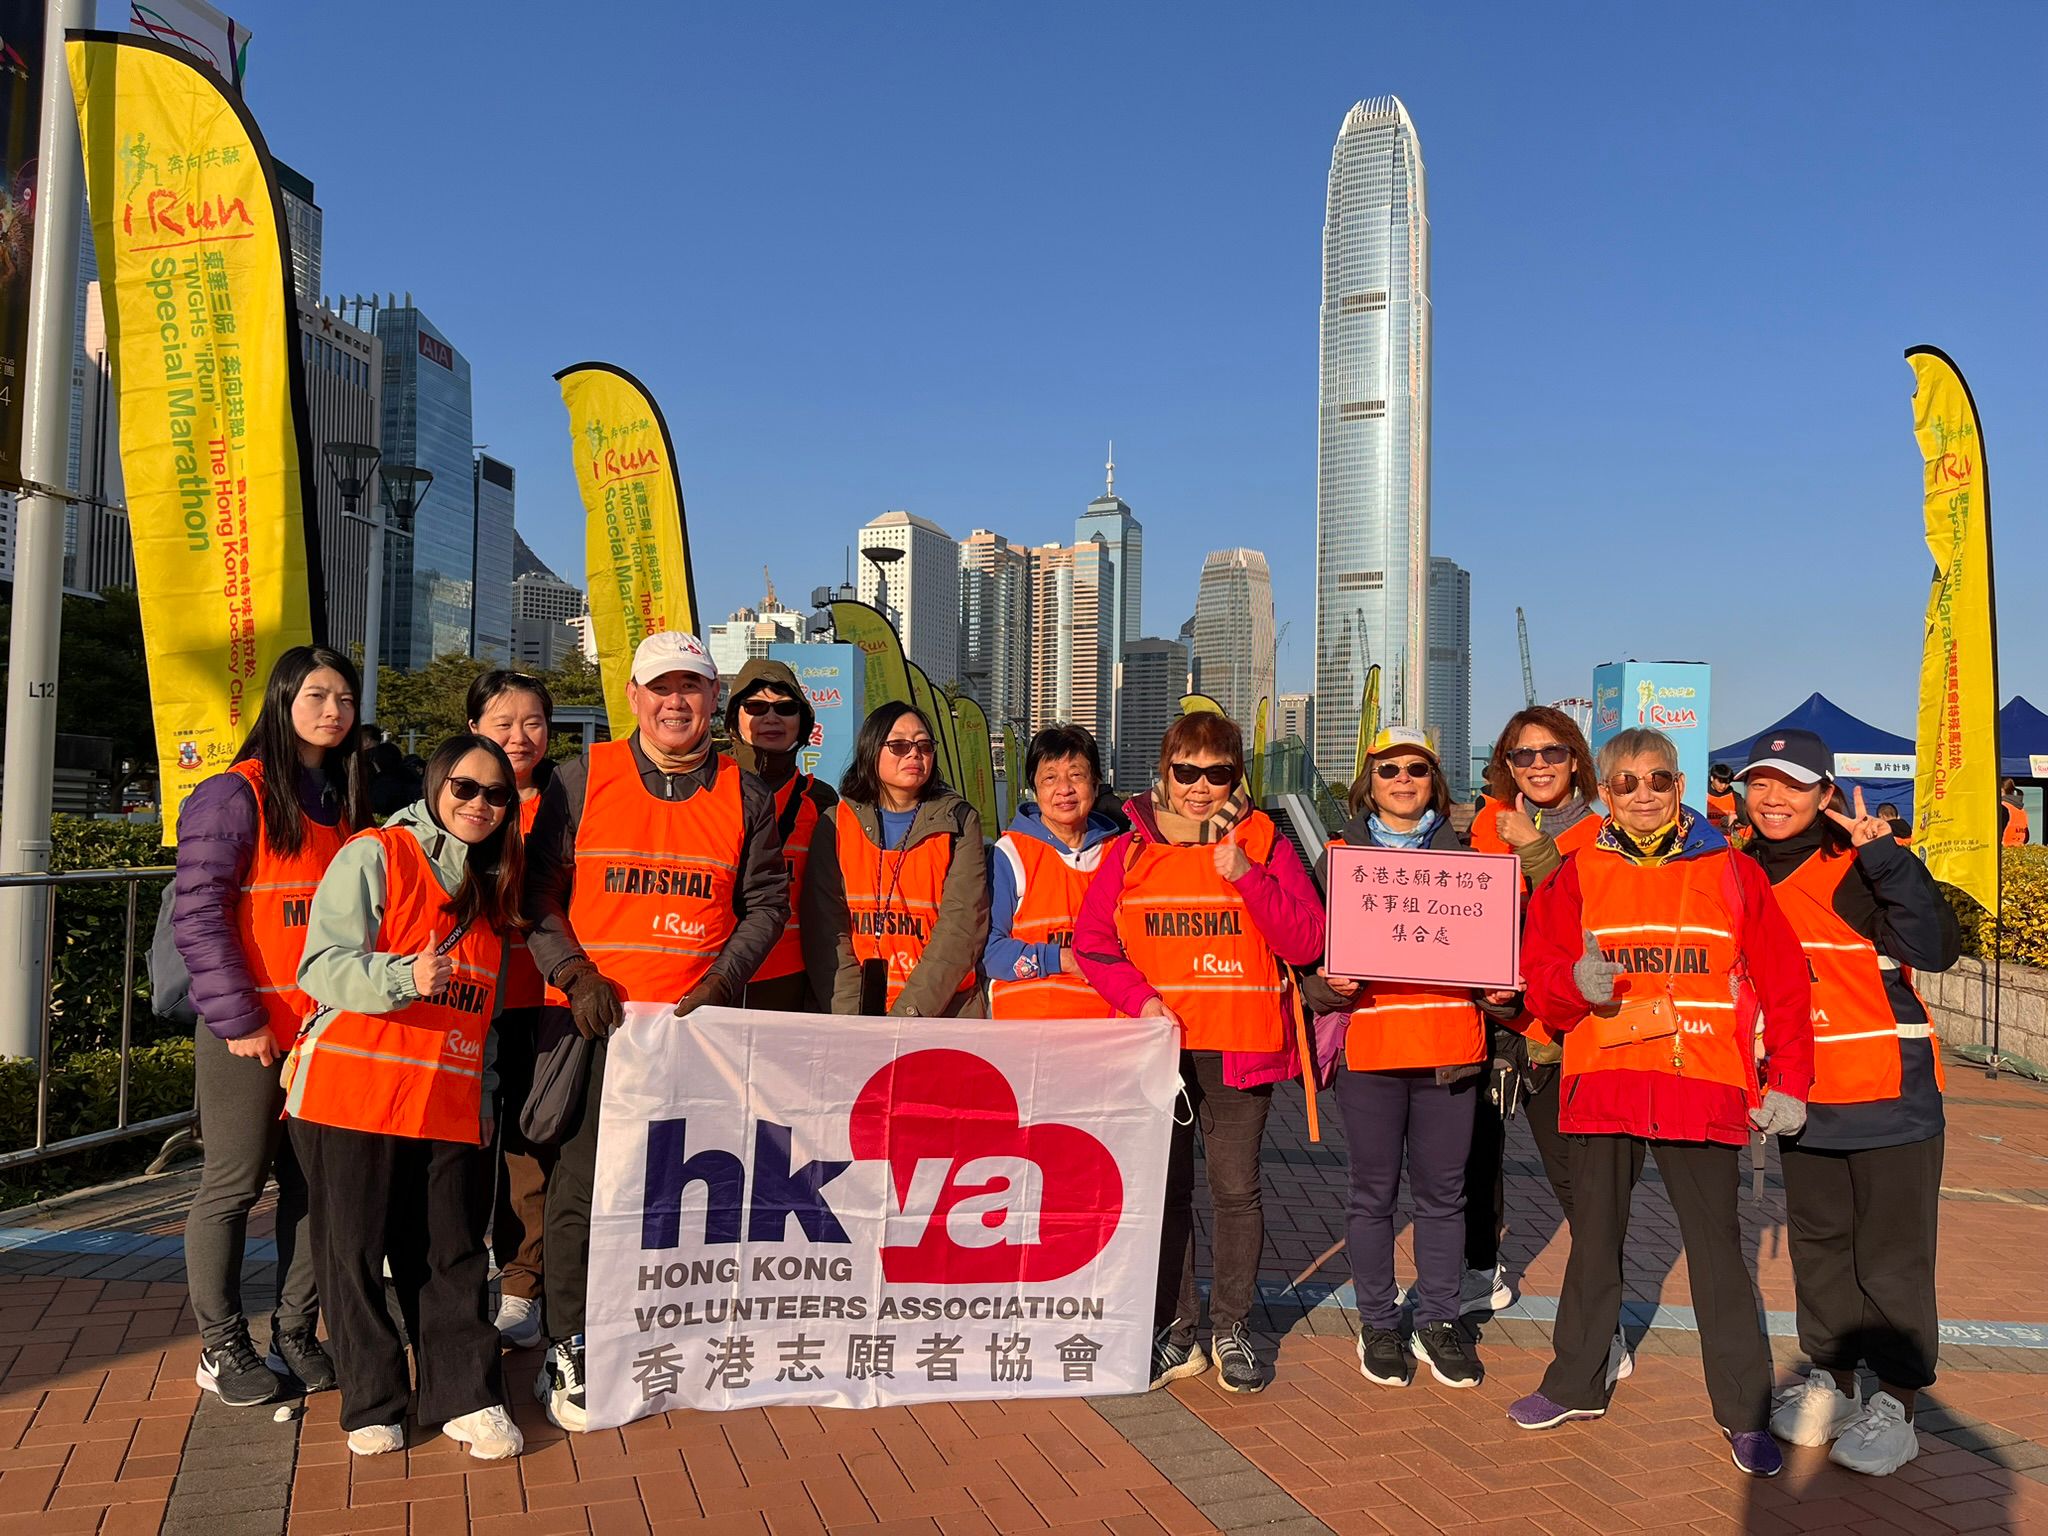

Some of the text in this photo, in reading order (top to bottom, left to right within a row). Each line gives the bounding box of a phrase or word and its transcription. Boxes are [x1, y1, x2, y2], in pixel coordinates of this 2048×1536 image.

[168, 146, 241, 175] 奔向共融
[182, 251, 208, 338] TWGHs
[423, 337, 449, 367] AIA
[146, 257, 211, 551] Special Marathon
[208, 435, 227, 476] The
[214, 479, 233, 537] Hong
[604, 487, 629, 562] Special
[619, 484, 636, 535] TWGHs
[640, 591, 653, 616] The
[222, 541, 239, 598] Kong
[228, 602, 243, 674] Jockey
[29, 681, 55, 698] L12
[229, 678, 244, 727] Club
[1874, 763, 1910, 772] 晶片計時
[1934, 769, 1947, 800] Club
[604, 867, 713, 899] MARSHAL
[1351, 865, 1493, 890] 香港志願者協會
[1144, 911, 1242, 936] MARSHAL
[1361, 894, 1483, 917] 賽事組 Zone3
[1392, 923, 1451, 945] 集合處
[640, 1118, 1045, 1251] hkva
[637, 1256, 853, 1291] HONG KONG
[634, 1296, 1104, 1332] VOLUNTEERS ASSOCIATION
[632, 1332, 1104, 1401] 香港志願者協會
